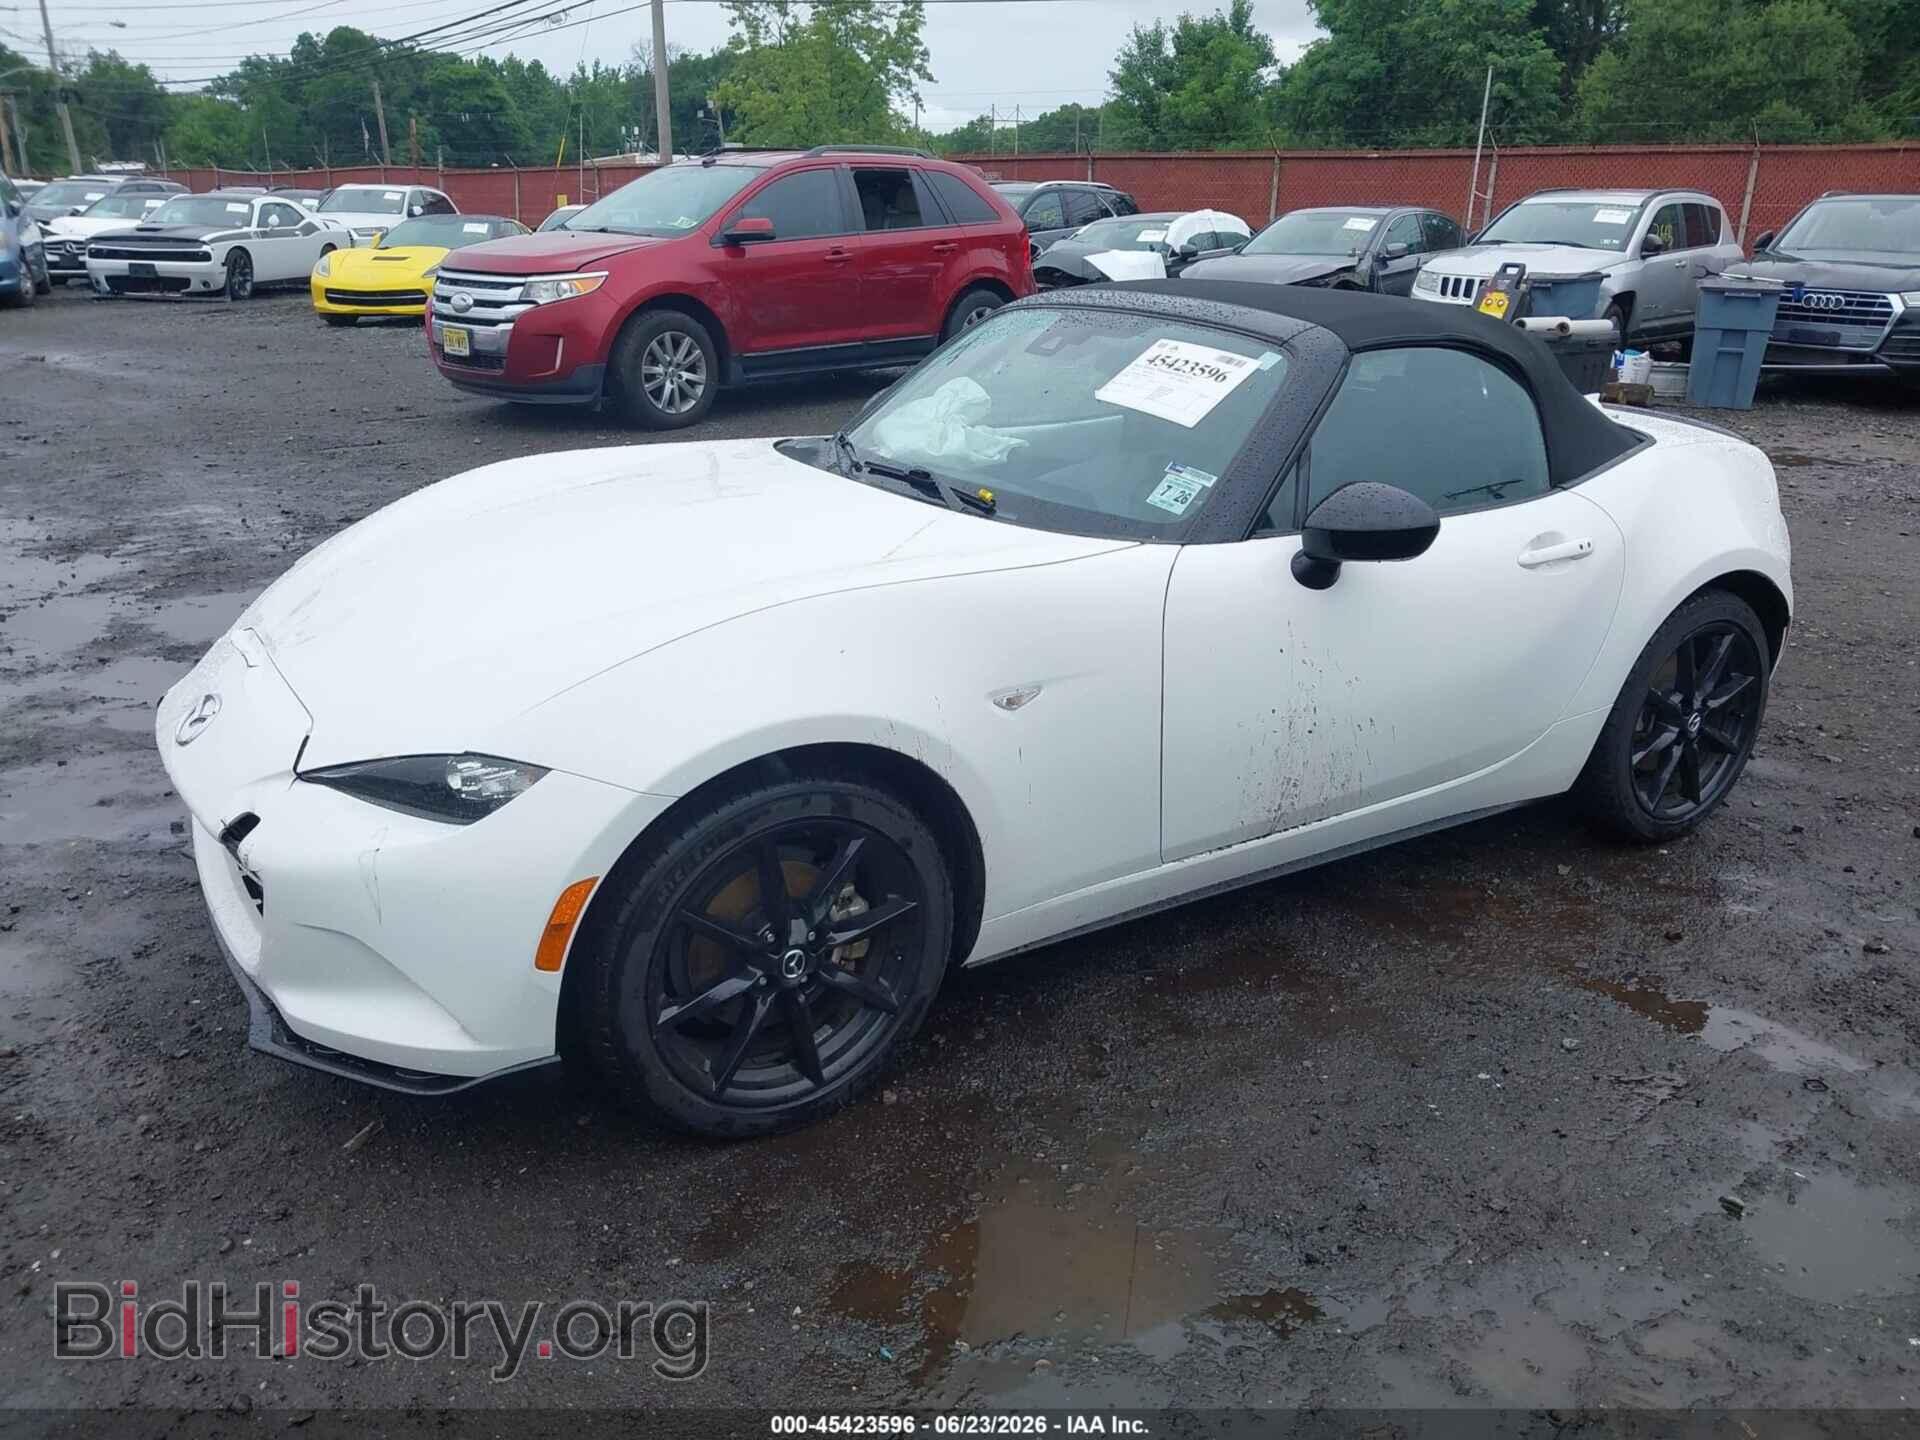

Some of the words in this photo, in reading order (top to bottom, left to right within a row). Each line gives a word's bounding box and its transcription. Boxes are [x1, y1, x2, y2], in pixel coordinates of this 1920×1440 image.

[1146, 353, 1232, 383] 45423596
[1159, 485, 1173, 497] 7
[1173, 490, 1192, 505] 26
